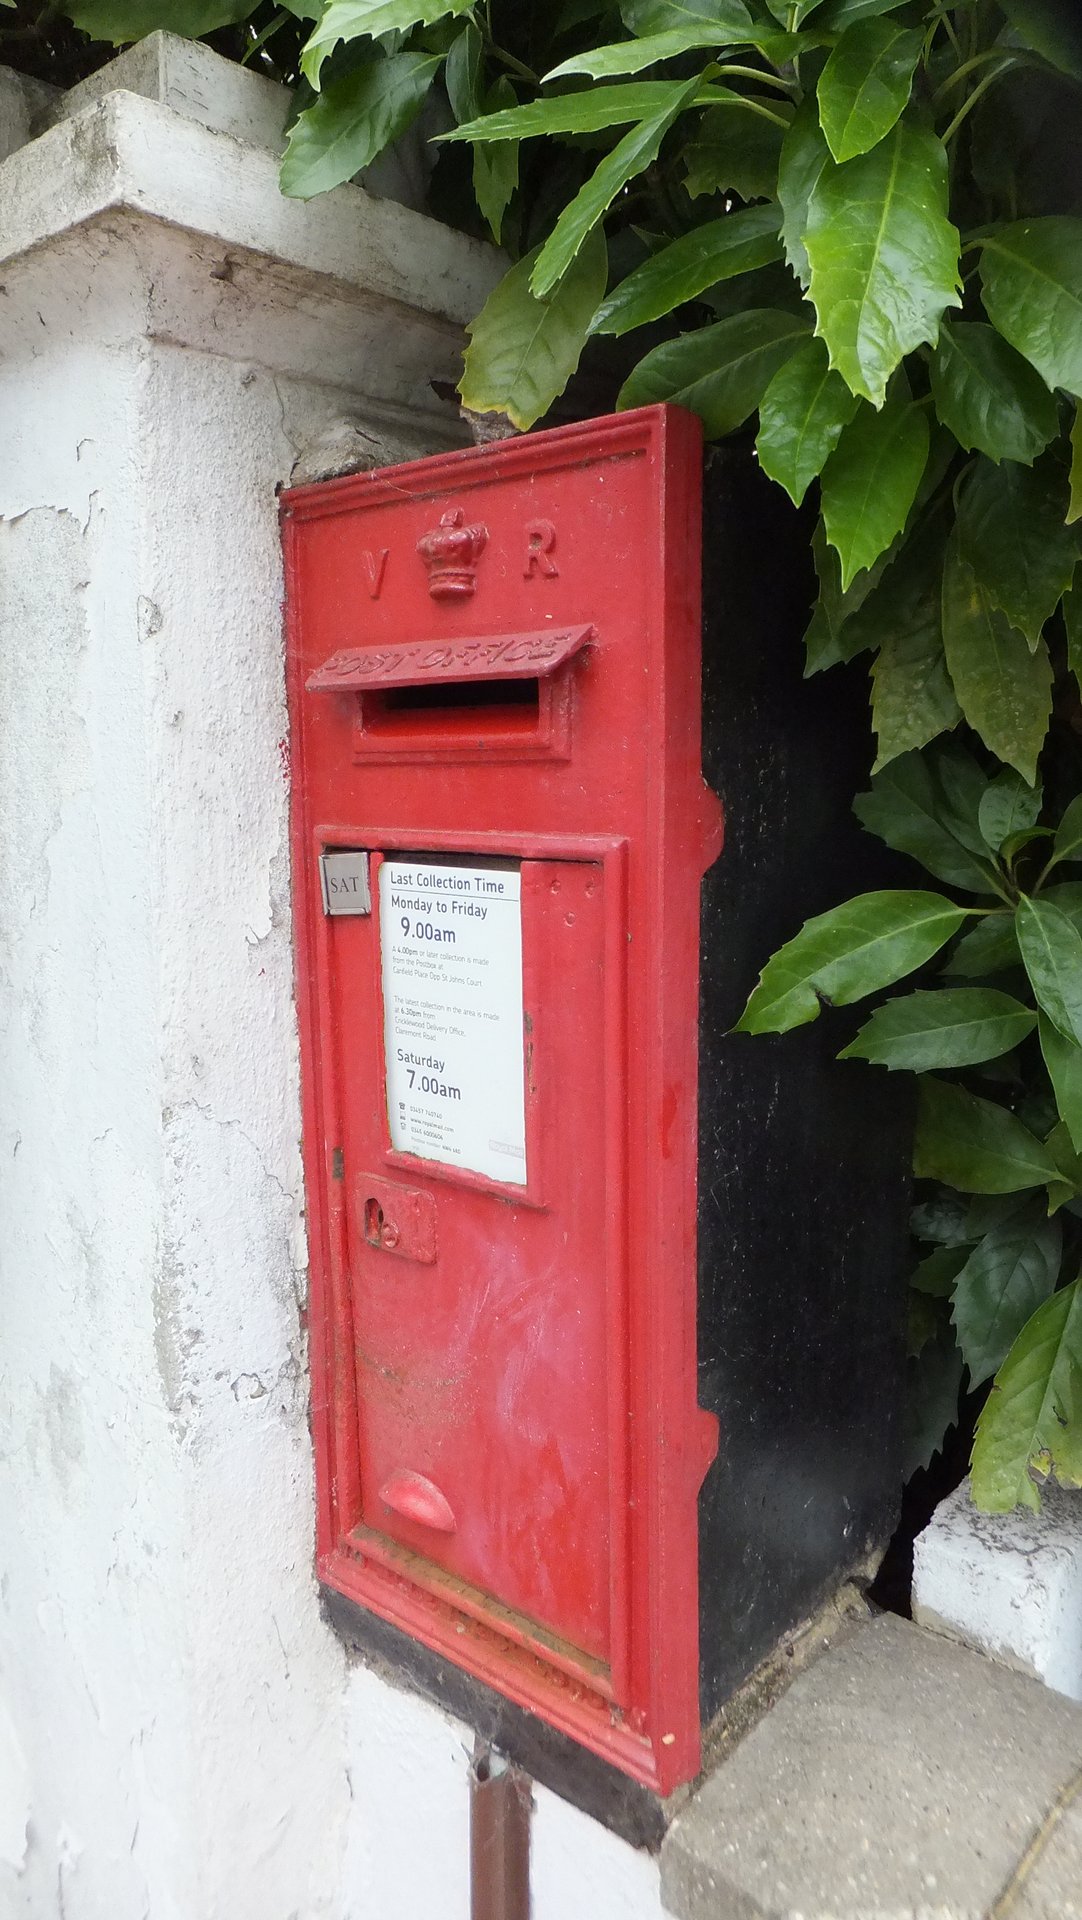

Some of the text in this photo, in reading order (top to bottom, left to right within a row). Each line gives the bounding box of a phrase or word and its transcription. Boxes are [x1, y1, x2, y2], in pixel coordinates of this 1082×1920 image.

[363, 518, 560, 600] V R
[324, 631, 573, 675] POST OFFICE
[330, 876, 359, 894] SAT
[390, 871, 505, 894] Last Collection Time
[391, 895, 488, 921] Monday to Friday
[400, 915, 456, 943] 9.00am
[392, 956, 405, 965] from
[406, 958, 415, 966] the
[397, 946, 418, 957] 4.00pm
[426, 949, 439, 959] later
[439, 952, 466, 963] collection
[472, 956, 490, 966] made
[414, 969, 429, 979] Place
[467, 977, 483, 987] Court
[394, 995, 404, 1004] The
[420, 1000, 445, 1011] collection
[453, 1006, 462, 1014] the
[463, 1008, 477, 1017] area
[483, 1012, 500, 1021] made
[400, 1007, 422, 1018] 6.30pm
[423, 1011, 436, 1020] from
[394, 1016, 426, 1029] Cricklewood
[426, 1022, 448, 1034] Delivery
[397, 1048, 446, 1073] Saturday
[406, 1068, 462, 1100] 7.00am
